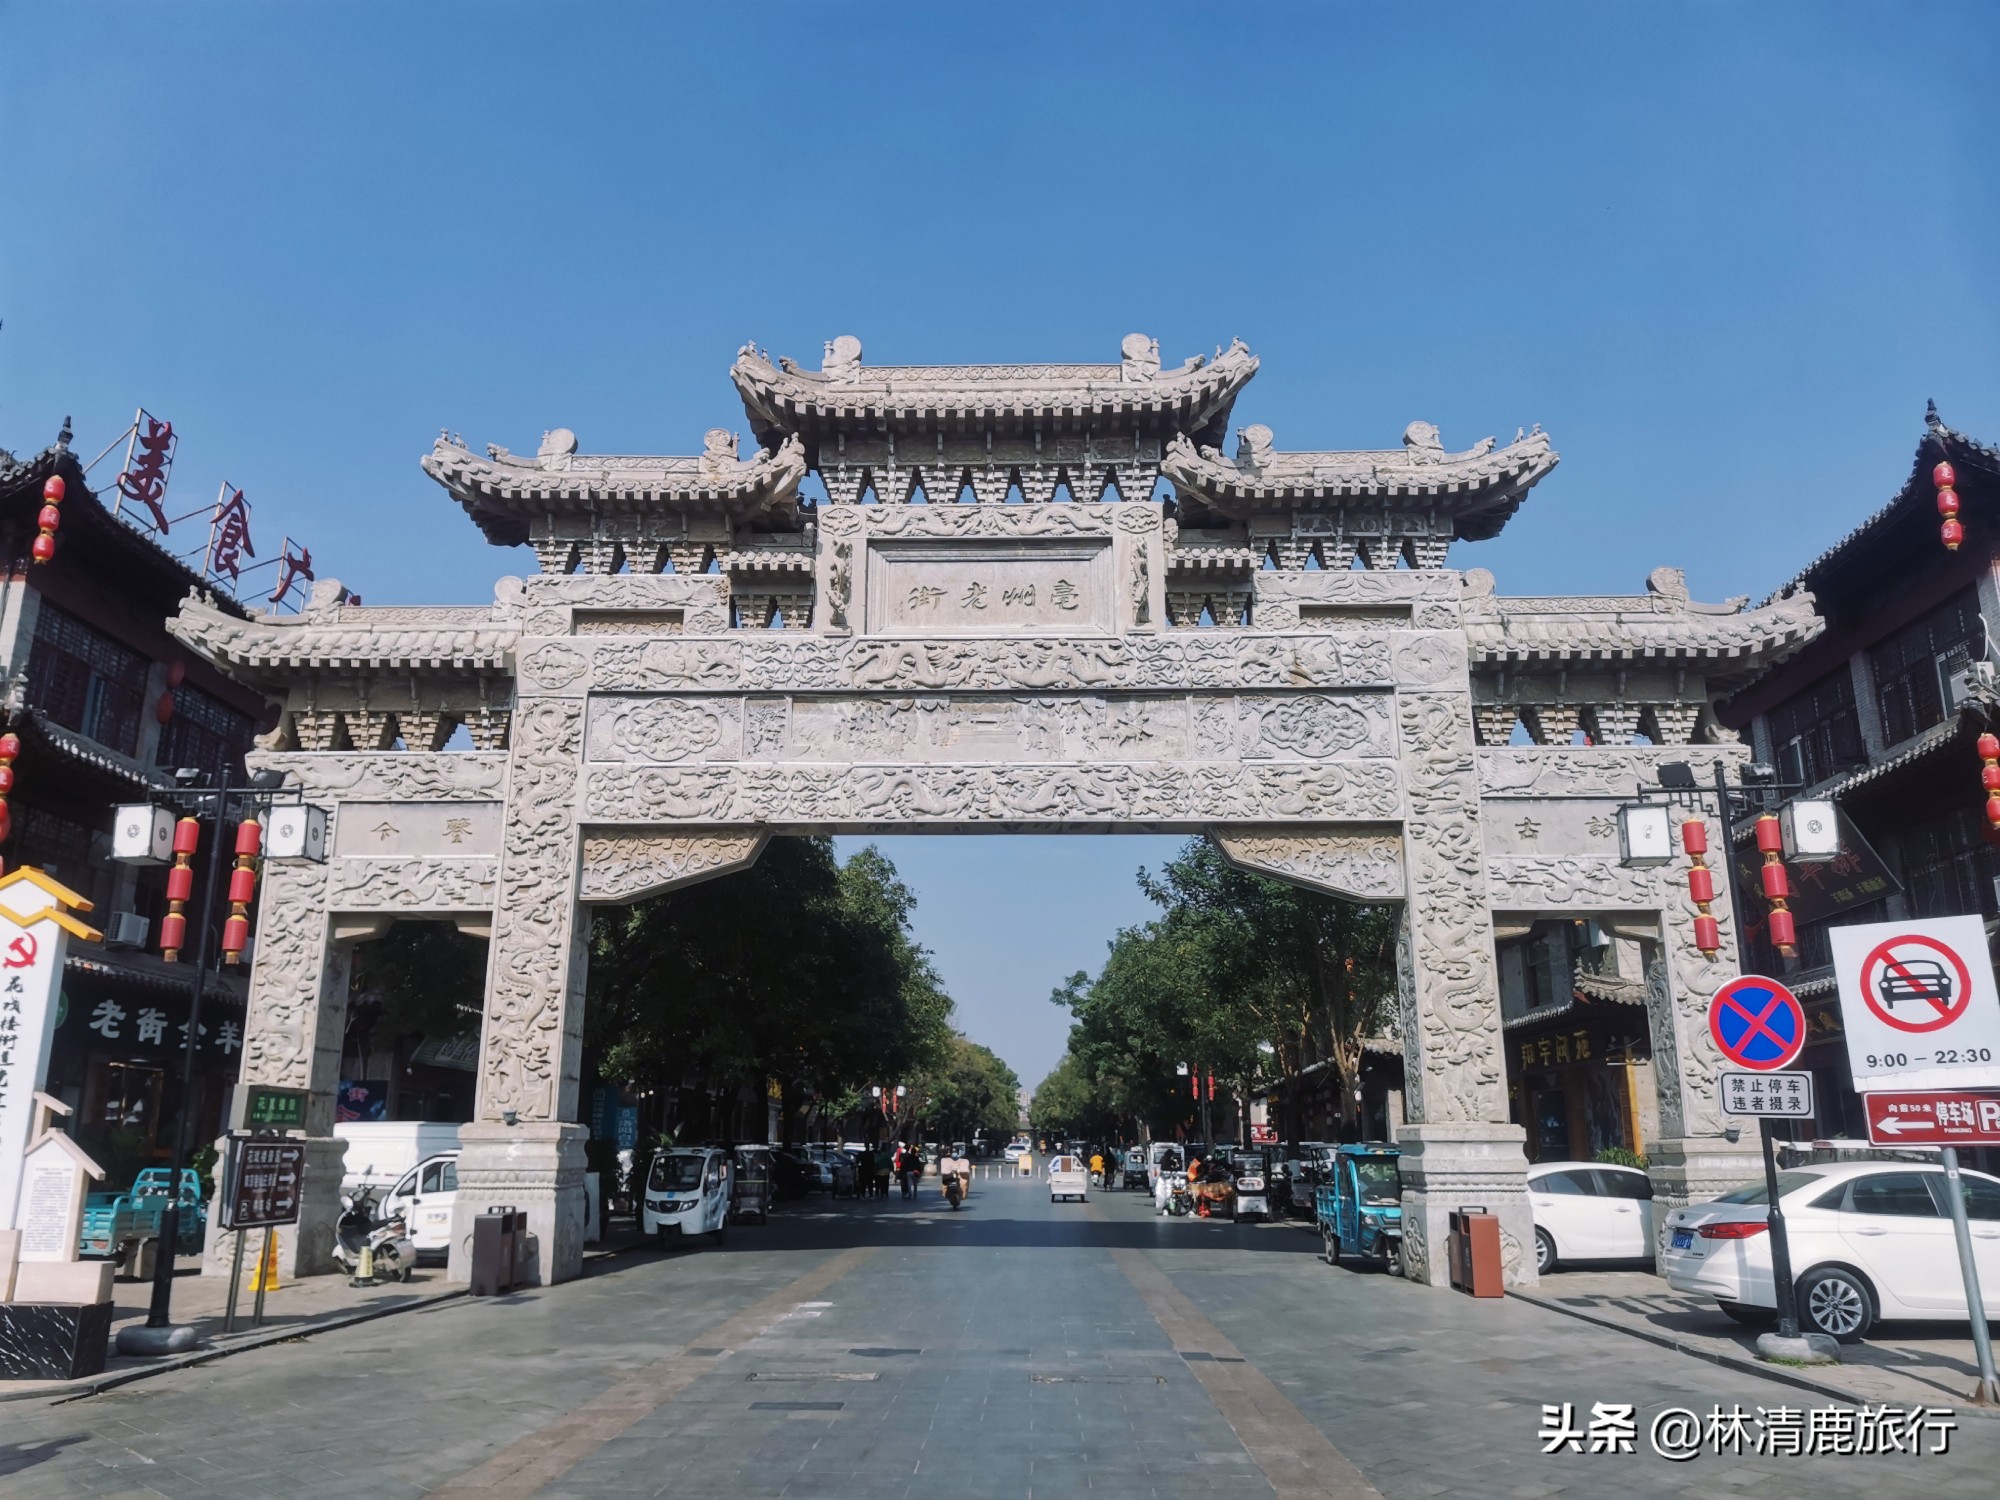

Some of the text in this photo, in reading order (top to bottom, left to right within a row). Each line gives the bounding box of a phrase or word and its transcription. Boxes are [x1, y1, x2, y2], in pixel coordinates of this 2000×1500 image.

[117, 418, 361, 605] 美食广
[1866, 1053, 1908, 1068] 9:00
[1934, 1048, 1992, 1064] 22:30
[1731, 1078, 1801, 1094] 禁止停车
[1733, 1095, 1802, 1111] 违者摄录
[1887, 1103, 1932, 1113] 向前50米
[1935, 1101, 1975, 1126] 停车场
